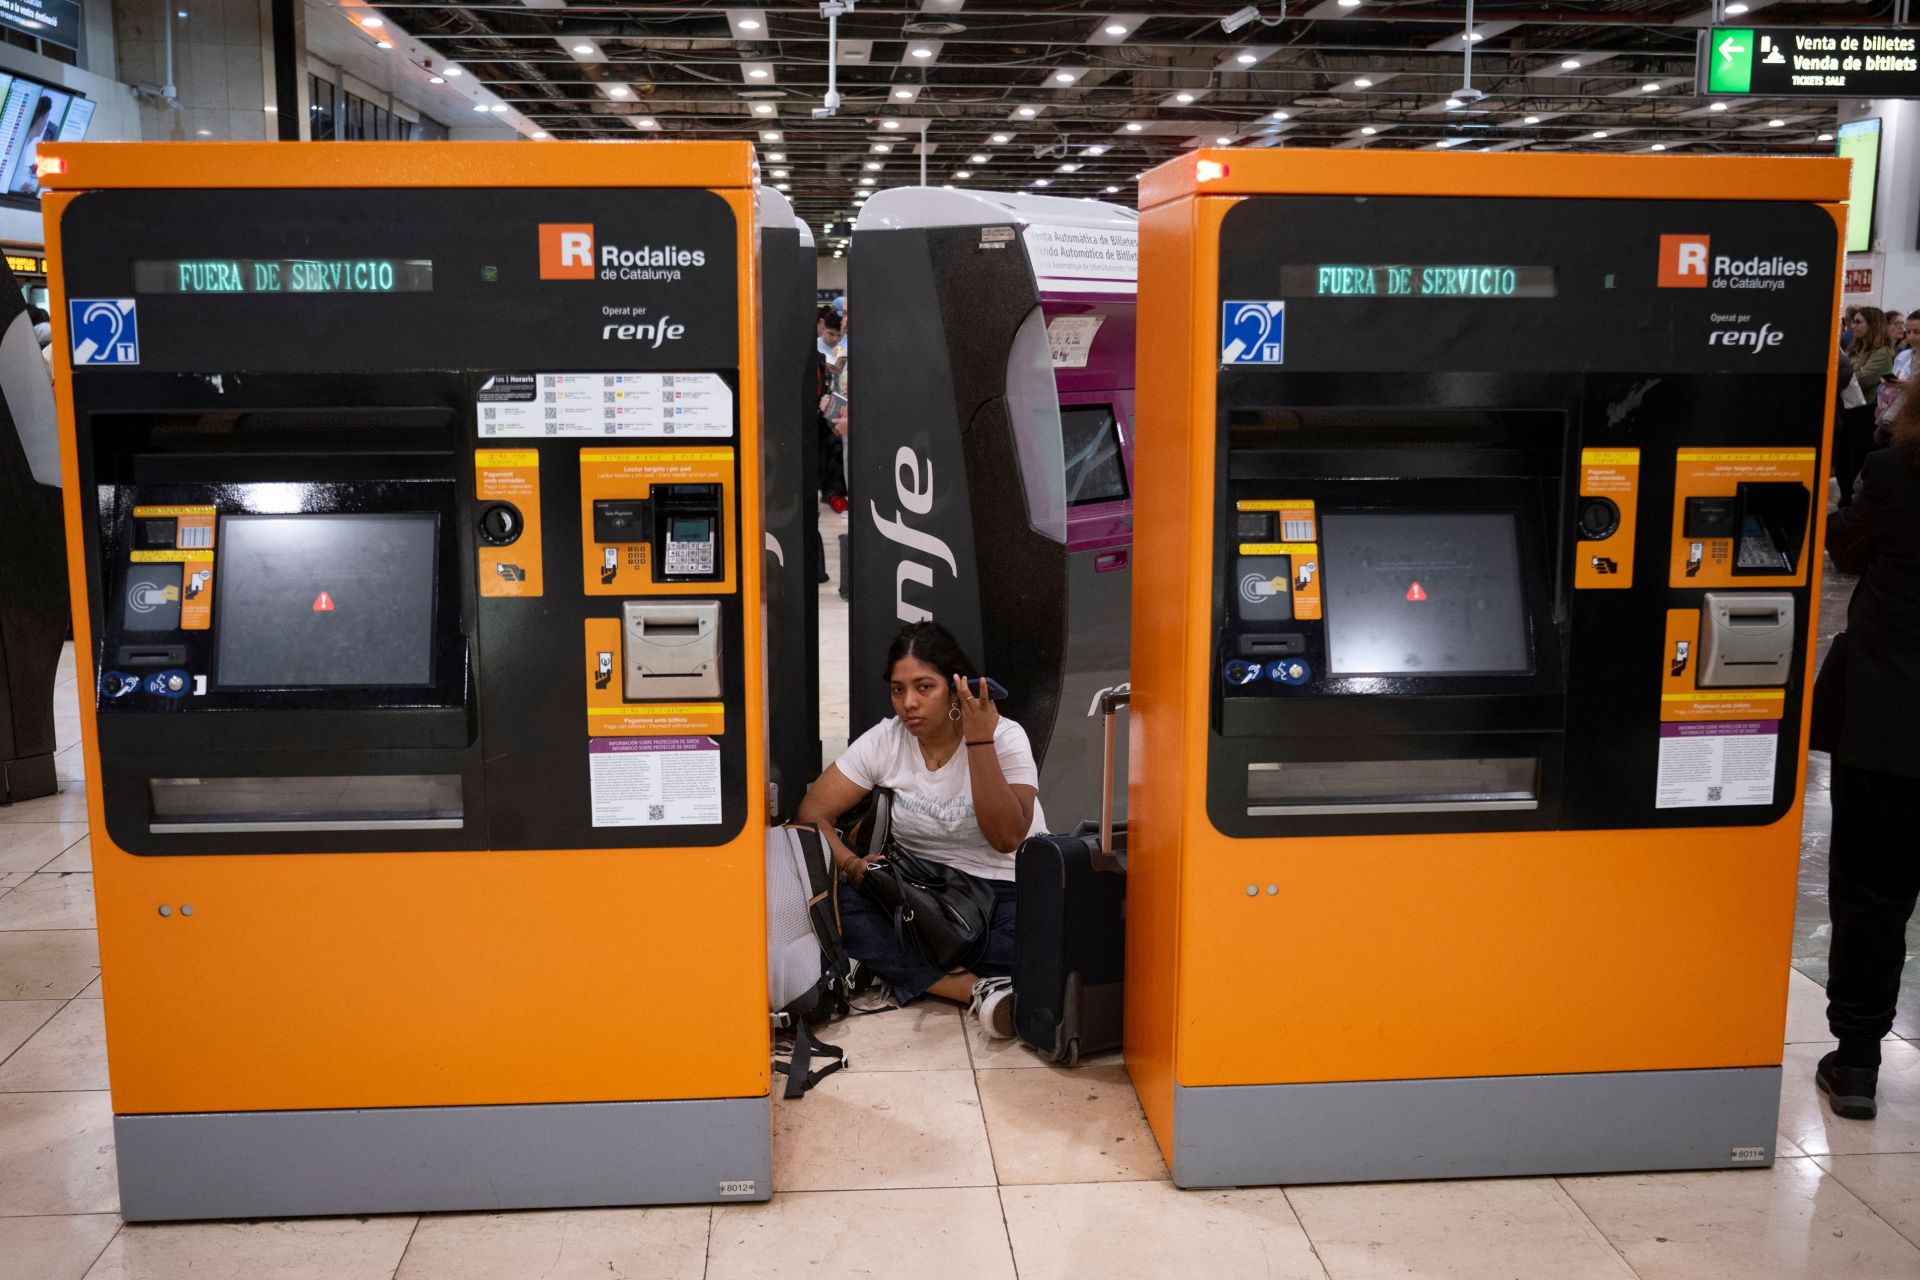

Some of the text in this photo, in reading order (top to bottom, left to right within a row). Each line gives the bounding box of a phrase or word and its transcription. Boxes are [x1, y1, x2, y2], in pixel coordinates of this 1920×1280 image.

[1796, 35, 1915, 51] Venta de billetes
[1793, 55, 1917, 71] Venda de bitllets
[1792, 76, 1845, 86] TICKETS SALE
[1055, 232, 1098, 245] Automática
[1100, 234, 1109, 245] de
[560, 232, 593, 267] R
[601, 245, 706, 267] Rodalies
[1106, 250, 1114, 260] de
[1116, 250, 1138, 261] Bitllet
[1678, 243, 1707, 275] R
[1714, 256, 1808, 277] Rodalies
[179, 261, 393, 291] FUERA DE SERVICIO
[600, 268, 681, 282] de Catalunya
[1317, 267, 1515, 295] FUERA DE SERVICIO
[1712, 278, 1785, 291] de Catalunya
[602, 306, 646, 316] Operat per
[1710, 313, 1751, 324] Operat per
[602, 315, 685, 349] renfe
[1708, 323, 1784, 354] renfe
[871, 446, 958, 624] nfe
[726, 1184, 748, 1192] 8012
